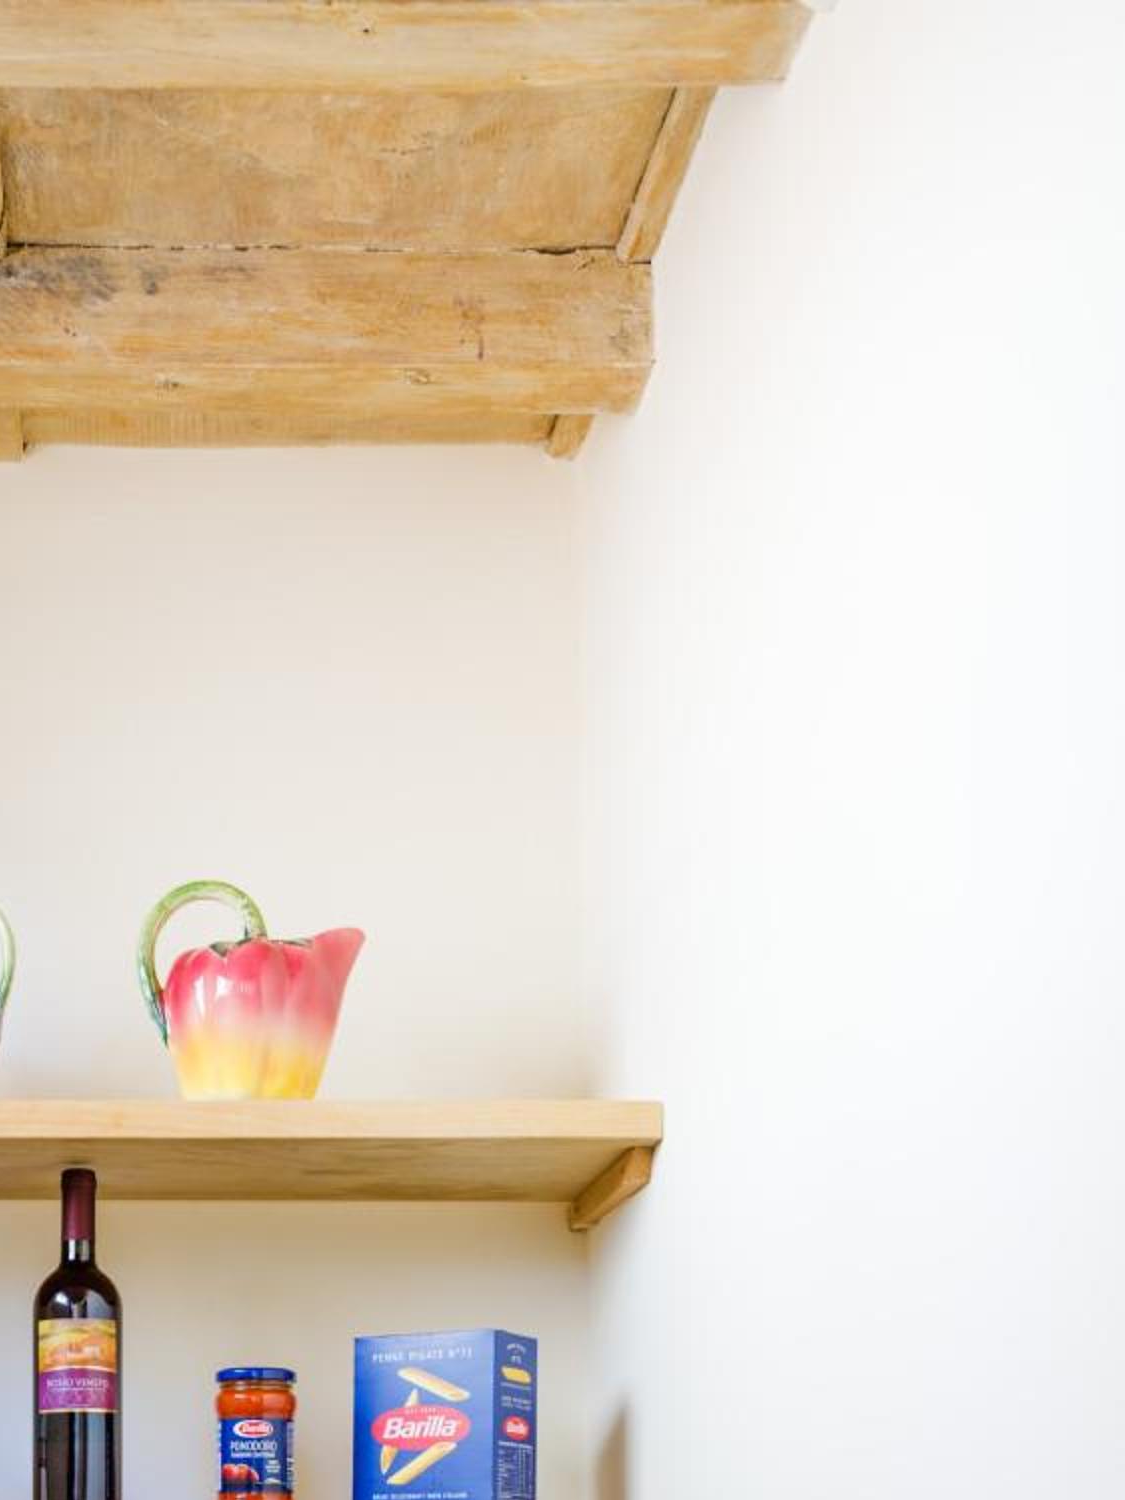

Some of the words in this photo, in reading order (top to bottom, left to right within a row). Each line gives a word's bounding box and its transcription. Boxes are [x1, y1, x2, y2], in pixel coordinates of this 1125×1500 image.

[373, 1351, 403, 1363] PENNE
[408, 1349, 443, 1361] RIGATE
[383, 1416, 458, 1438] Barilla
